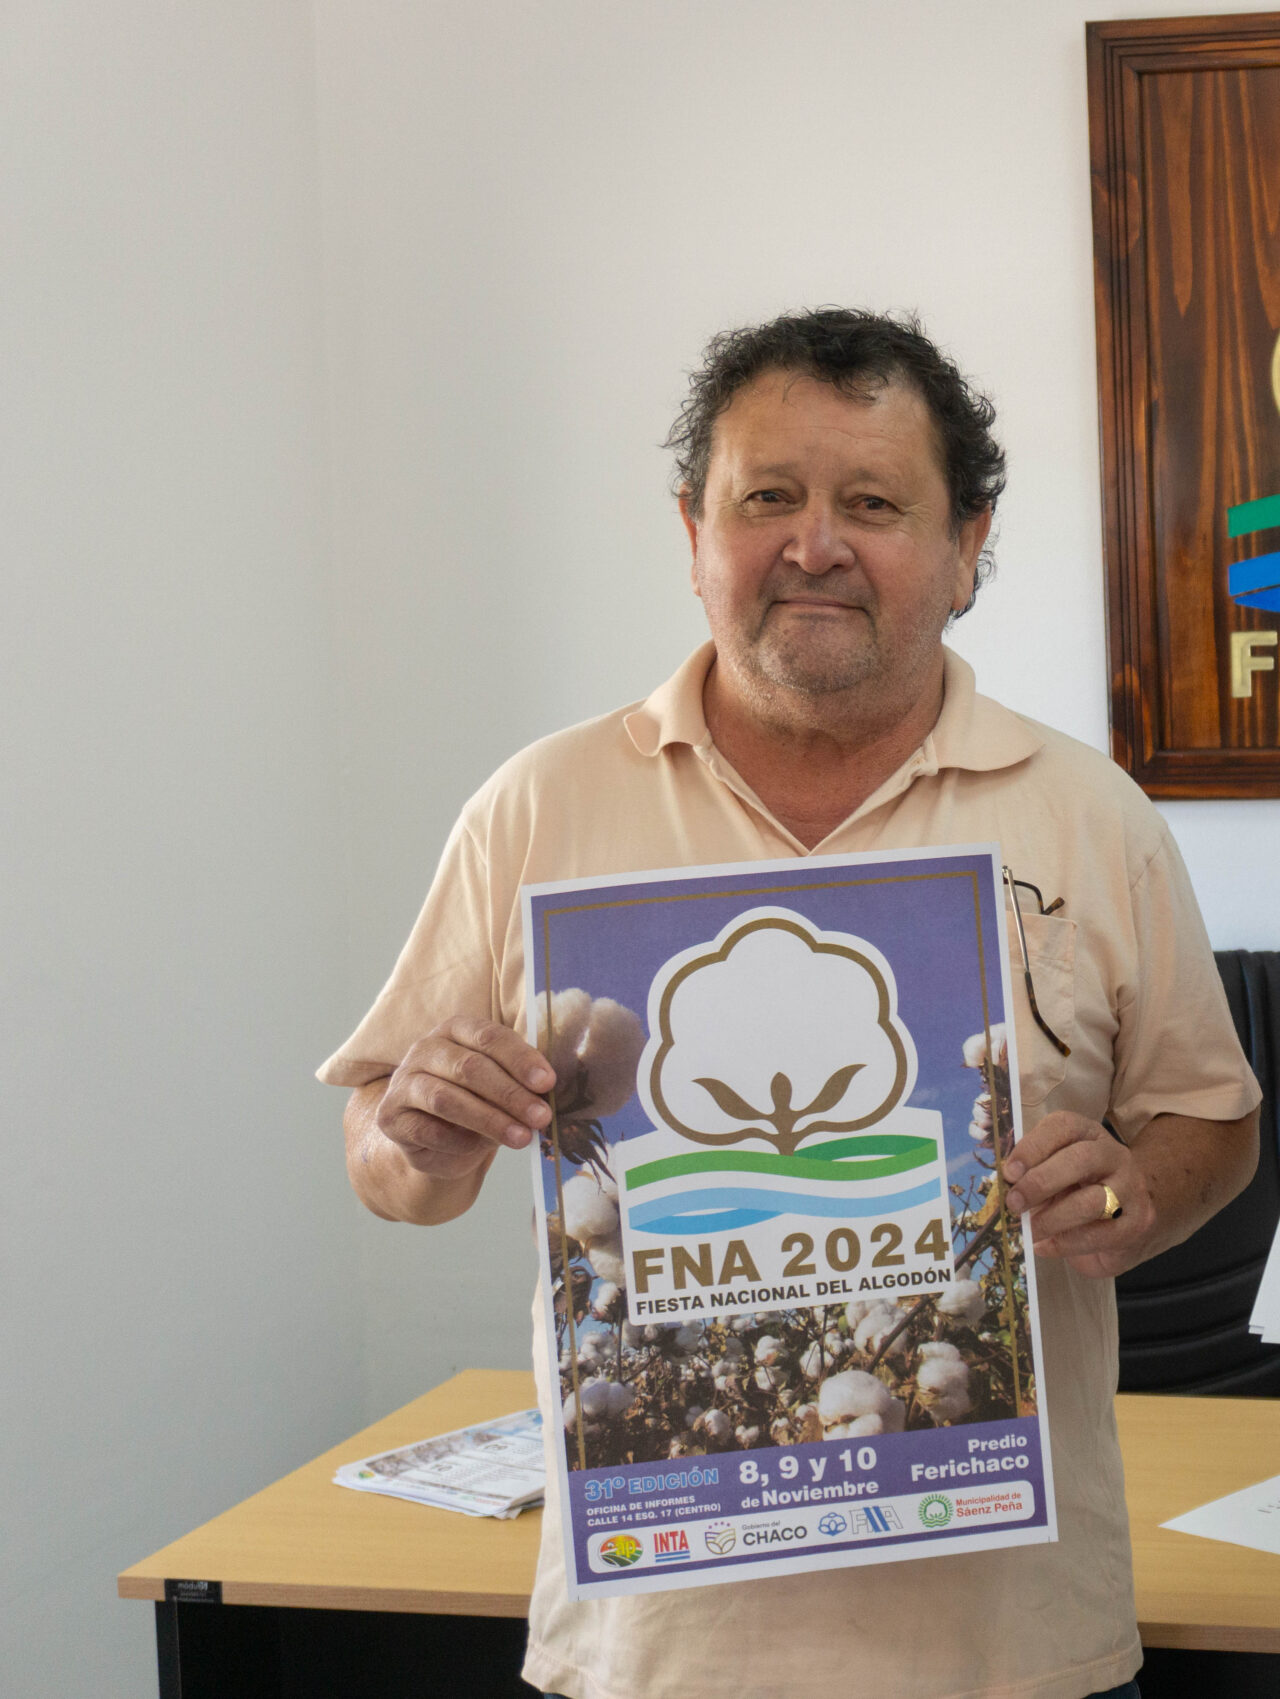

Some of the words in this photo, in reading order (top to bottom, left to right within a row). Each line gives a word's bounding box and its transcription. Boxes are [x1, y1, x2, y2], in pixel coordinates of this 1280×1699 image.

[632, 1239, 763, 1295] FNA
[780, 1218, 950, 1278] 2024
[636, 1294, 703, 1315] FIESTA
[711, 1283, 810, 1309] NACIONAL
[816, 1279, 853, 1296] DEL
[858, 1266, 951, 1291] ALGODÓN
[968, 1432, 1028, 1453] Predio
[739, 1460, 769, 1487] 8,
[778, 1455, 799, 1479] 9
[808, 1456, 827, 1482] y
[839, 1446, 878, 1472] 10
[911, 1454, 1030, 1482] Ferichaco
[628, 1465, 720, 1494] EDICIÓN
[586, 1503, 627, 1517] OFICINA
[629, 1502, 643, 1511] DE
[645, 1495, 696, 1509] INFORMES
[741, 1496, 760, 1509] de
[762, 1480, 879, 1507] Noviembre
[955, 1494, 1010, 1507] Municipalidad
[1011, 1491, 1021, 1500] de
[587, 1515, 619, 1527] CALLE
[621, 1514, 633, 1523] 14
[635, 1511, 659, 1521] ESQ.
[660, 1509, 672, 1518] 17
[675, 1502, 721, 1517] (CENTRO)
[956, 1505, 992, 1518] Sáenz
[994, 1500, 1023, 1513] Peña
[742, 1522, 771, 1531] Gobierno
[773, 1519, 781, 1527] del
[742, 1525, 808, 1546] CHACO
[653, 1530, 690, 1554] INTA
